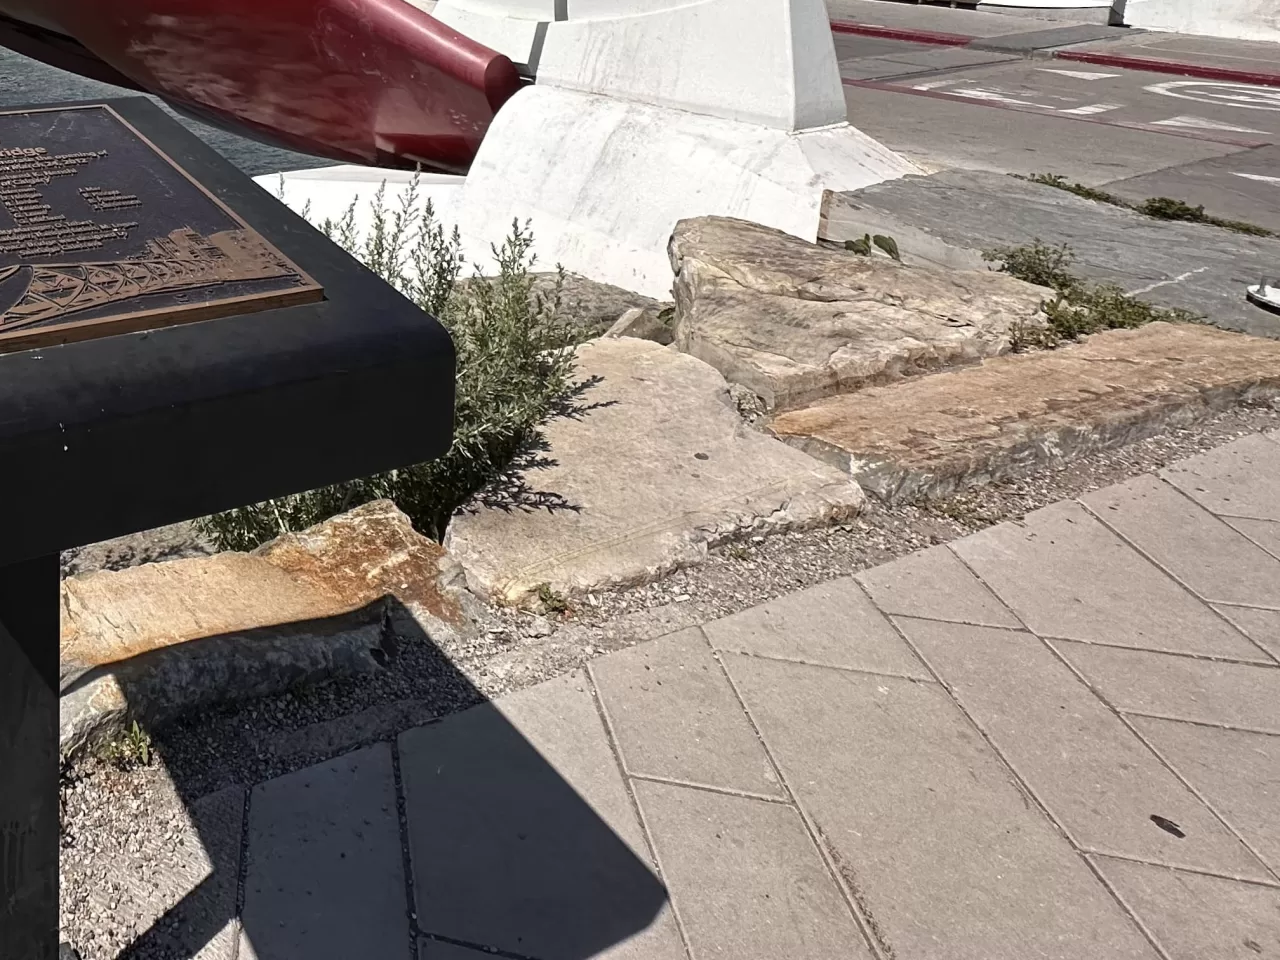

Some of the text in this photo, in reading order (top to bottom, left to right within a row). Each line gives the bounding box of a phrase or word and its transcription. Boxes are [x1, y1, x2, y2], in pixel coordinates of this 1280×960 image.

[12, 178, 51, 186] Calgary
[76, 233, 116, 241] designed
[20, 242, 102, 256] Santiago Calatrava
